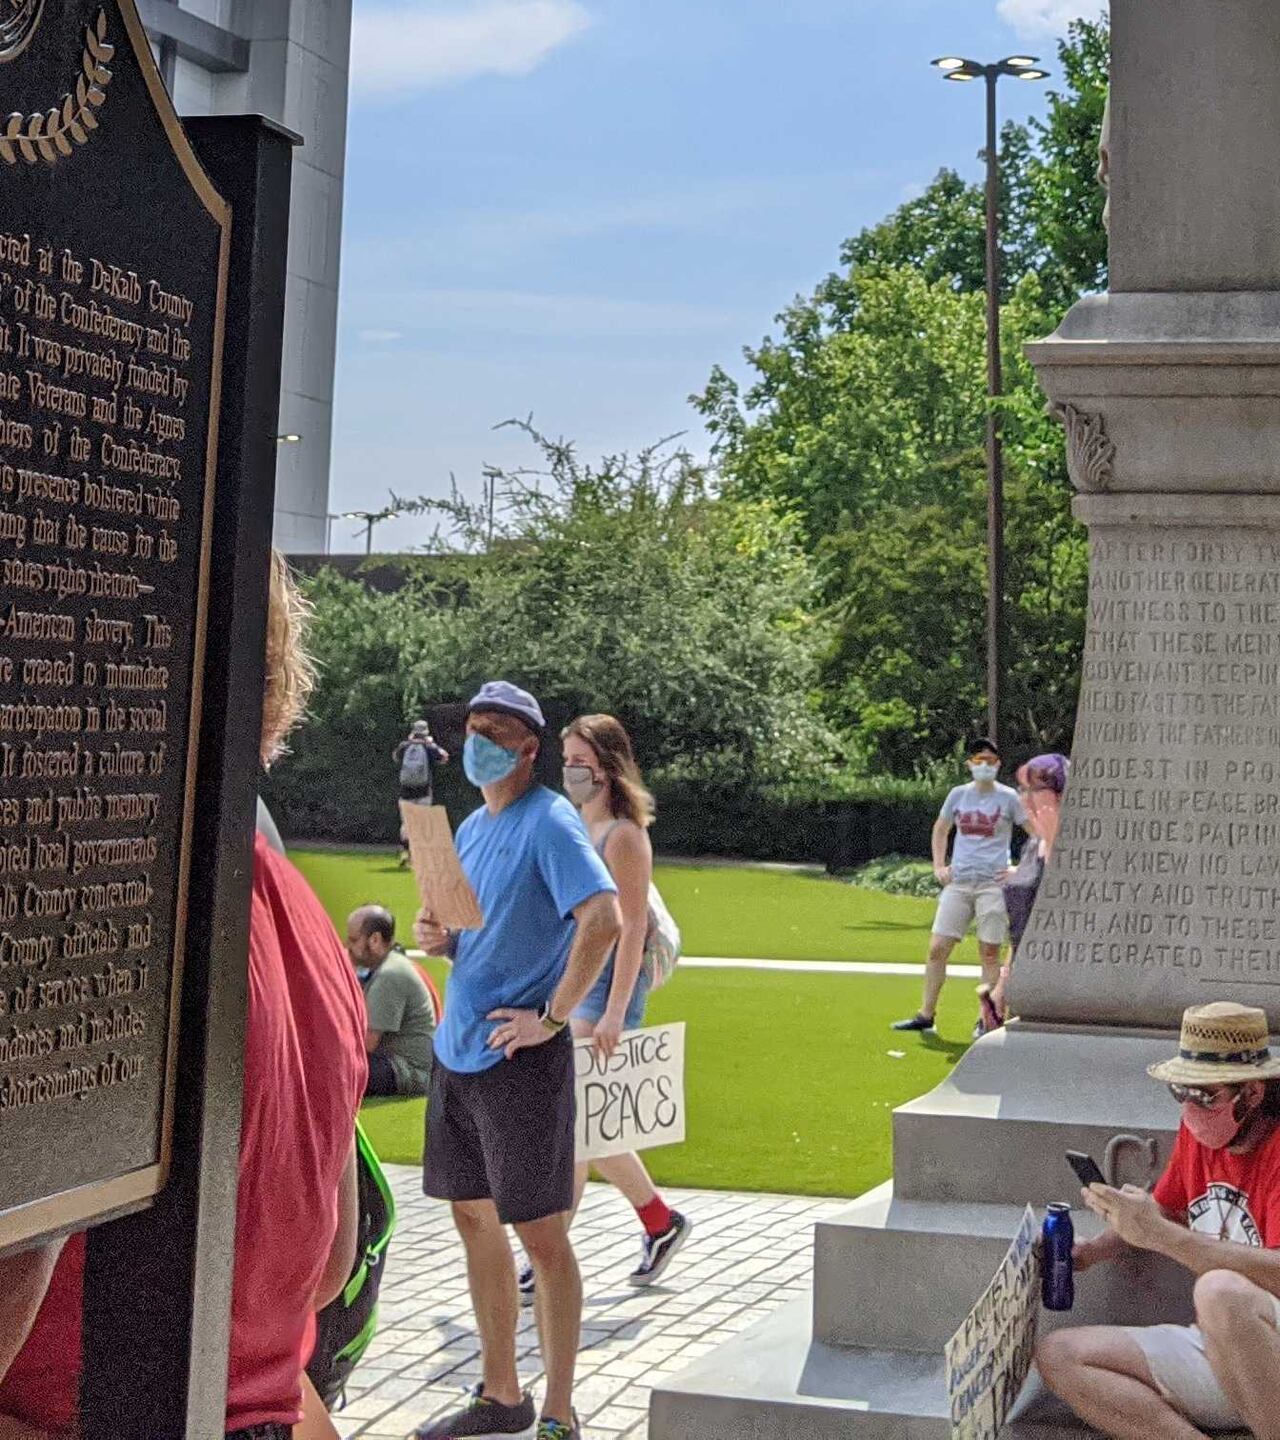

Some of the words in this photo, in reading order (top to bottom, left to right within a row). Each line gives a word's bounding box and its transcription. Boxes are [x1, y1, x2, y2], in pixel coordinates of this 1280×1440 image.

[35, 241, 54, 274] at
[60, 246, 84, 284] the
[92, 257, 143, 303] DeKalb
[12, 280, 32, 313] of
[33, 283, 57, 321] the
[59, 291, 144, 354] Confederacy
[16, 323, 33, 358] It
[32, 336, 62, 366] was
[60, 339, 124, 390] privately
[27, 371, 87, 416] Veterans
[90, 391, 118, 423] and
[40, 422, 60, 455] of
[69, 426, 91, 461] the
[1092, 571, 1186, 591] ANOTHER
[1091, 600, 1189, 622] WITNESS
[1197, 602, 1225, 622] TO
[1234, 603, 1277, 623] THE
[1088, 631, 1140, 653] THAT
[1148, 632, 1217, 653] THESE
[1226, 633, 1270, 654] MEN
[1085, 661, 1194, 683] COVENANT
[1072, 758, 1172, 780] MODEST
[1185, 760, 1208, 781] IN
[1066, 788, 1145, 809] GENTLE
[1152, 790, 1170, 811] IN
[1056, 847, 1111, 871] THEY
[1125, 851, 1188, 874] KNEW
[1200, 853, 1227, 876] NO
[1044, 880, 1141, 903] LOYALTY
[1152, 884, 1194, 905] AND
[1107, 913, 1153, 934] AND
[1165, 914, 1190, 936] TO
[1201, 916, 1275, 941] THESE
[1026, 940, 1202, 968] CONSECRATED
[573, 1031, 671, 1077] JUSTICE
[584, 1075, 677, 1147] PEACE
